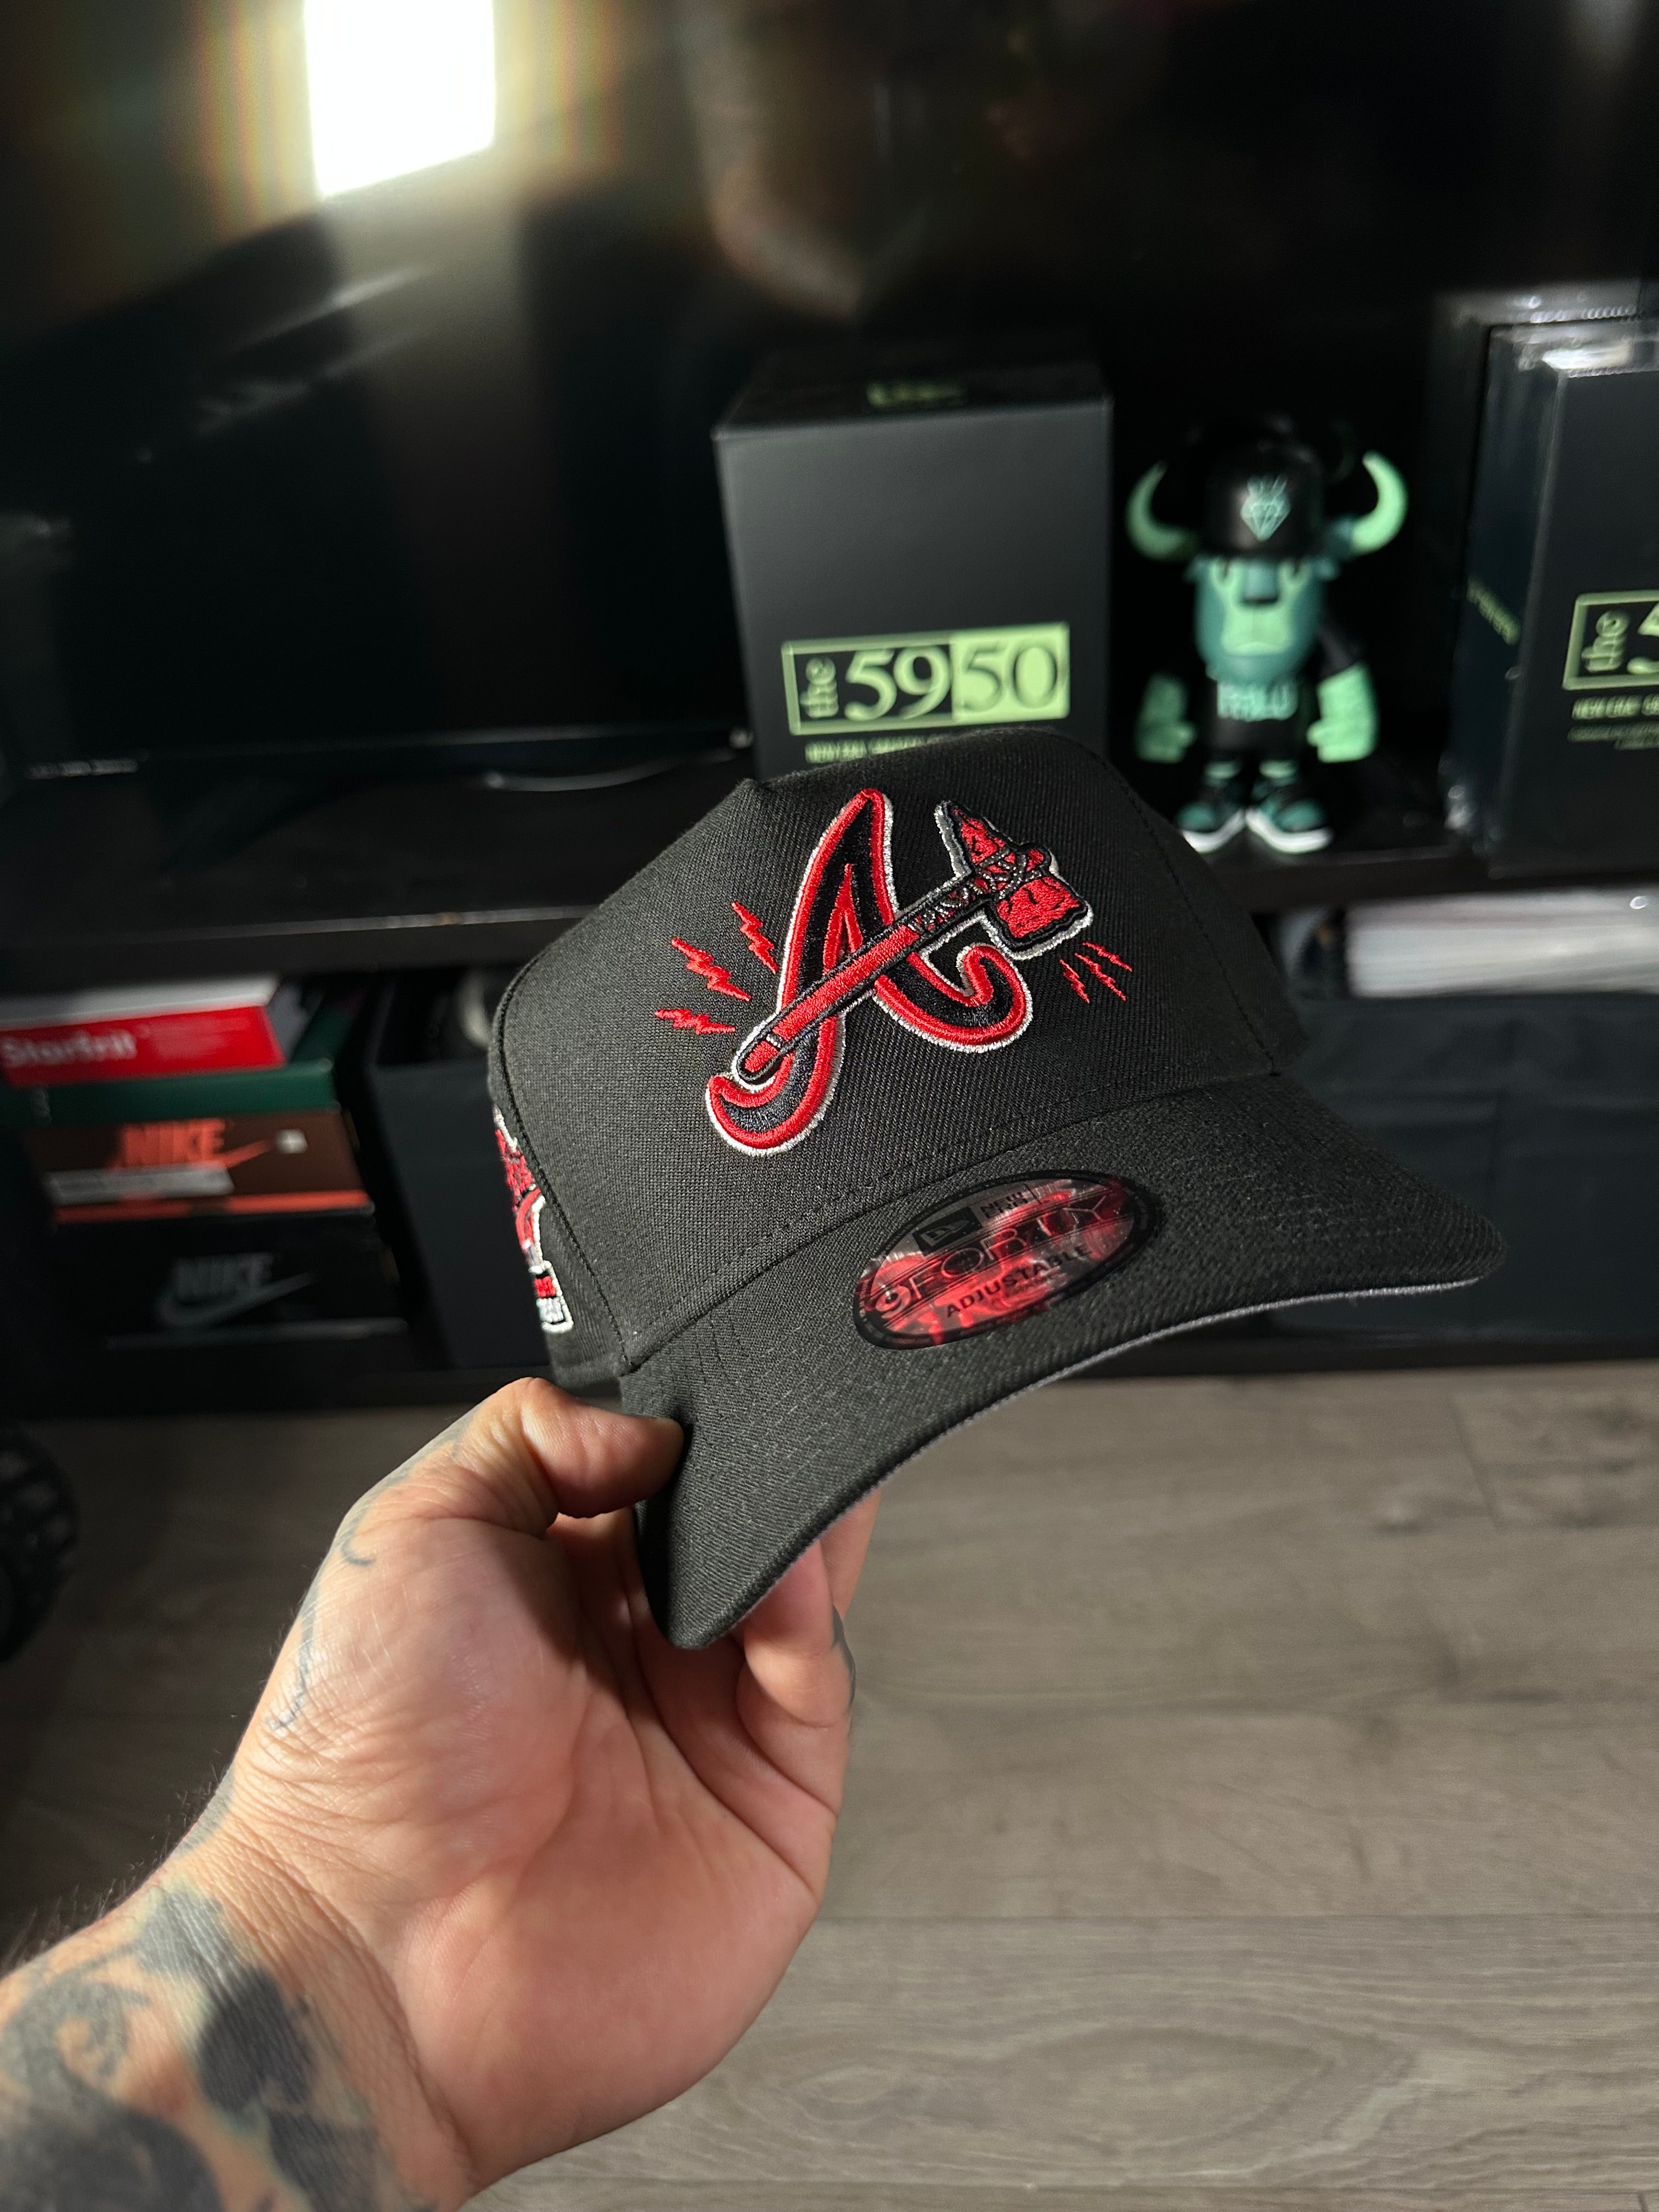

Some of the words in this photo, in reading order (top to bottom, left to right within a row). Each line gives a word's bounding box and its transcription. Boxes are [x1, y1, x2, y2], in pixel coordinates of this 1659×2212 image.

[844, 638, 1060, 722] 5950
[121, 1118, 226, 1168] NIKE
[171, 1251, 273, 1299] NIKE
